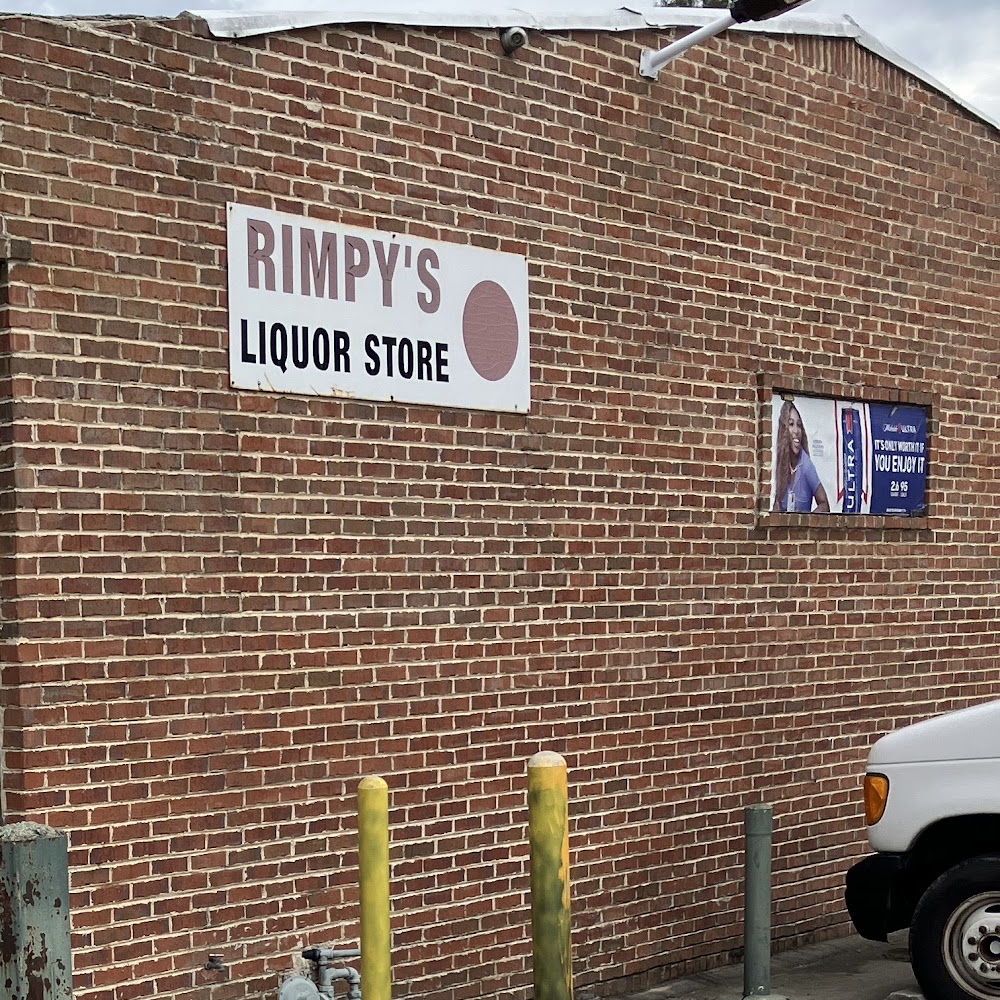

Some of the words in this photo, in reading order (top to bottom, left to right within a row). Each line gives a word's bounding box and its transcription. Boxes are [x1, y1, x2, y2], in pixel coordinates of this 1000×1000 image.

[246, 218, 441, 314] RIMPY'S
[240, 318, 351, 374] LIQUOR
[364, 333, 450, 383] STORE
[846, 439, 856, 509] ULTRA
[874, 453, 891, 472] YOU
[892, 455, 917, 473] ENJOY
[917, 456, 925, 474] IT
